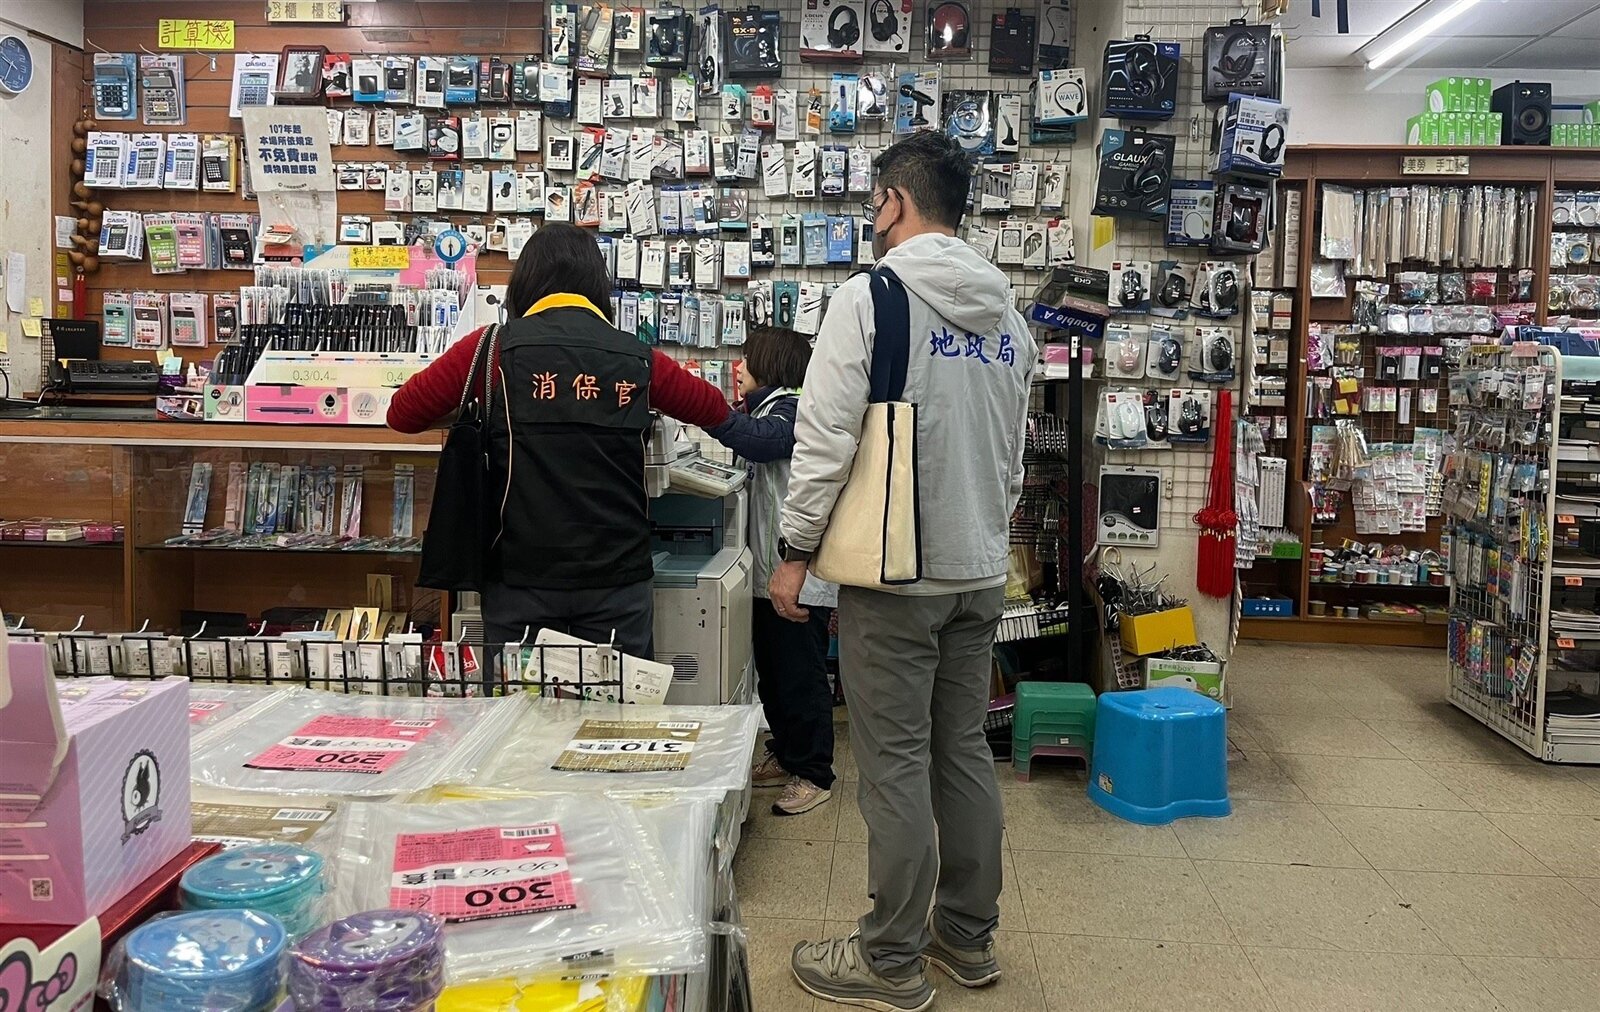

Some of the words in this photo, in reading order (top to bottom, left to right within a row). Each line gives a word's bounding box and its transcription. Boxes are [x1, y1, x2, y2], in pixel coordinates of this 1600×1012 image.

[161, 20, 232, 46] 計算機
[1058, 93, 1079, 101] WAVE
[269, 124, 302, 134] 107年起
[259, 136, 314, 146] 本場所依規定
[258, 147, 318, 162] 不免費提供
[1113, 152, 1148, 165] GLAUX
[1043, 310, 1055, 320] A
[1056, 313, 1097, 333] Double
[930, 326, 1015, 368] 地政局
[532, 371, 637, 408] 消保官
